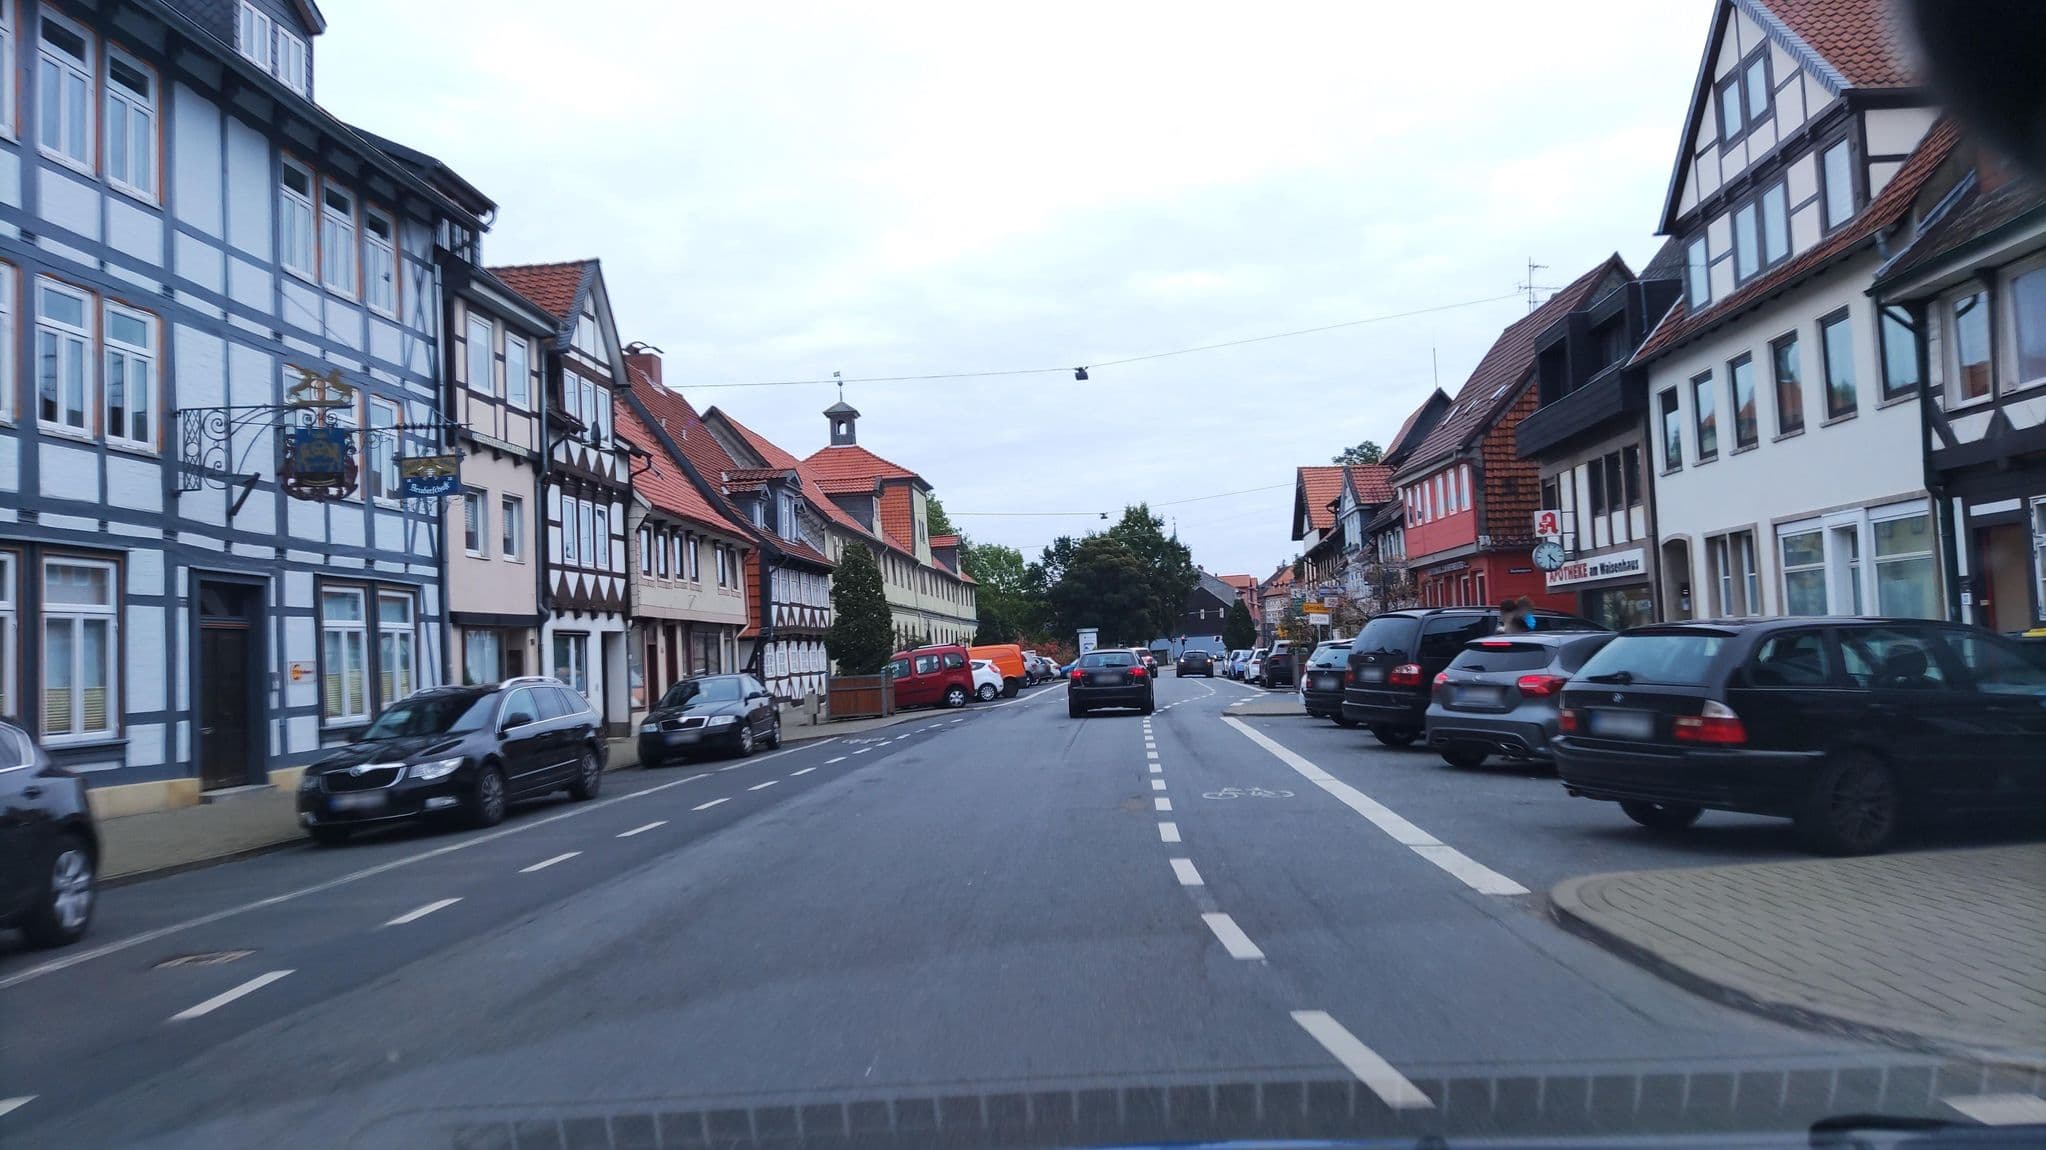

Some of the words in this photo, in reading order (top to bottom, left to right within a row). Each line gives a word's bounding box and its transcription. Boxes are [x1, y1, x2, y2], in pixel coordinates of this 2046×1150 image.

[1537, 511, 1559, 535] A
[1549, 562, 1588, 583] APOTHEKE
[1589, 566, 1598, 577] am
[1599, 559, 1639, 575] Waisenhaus
